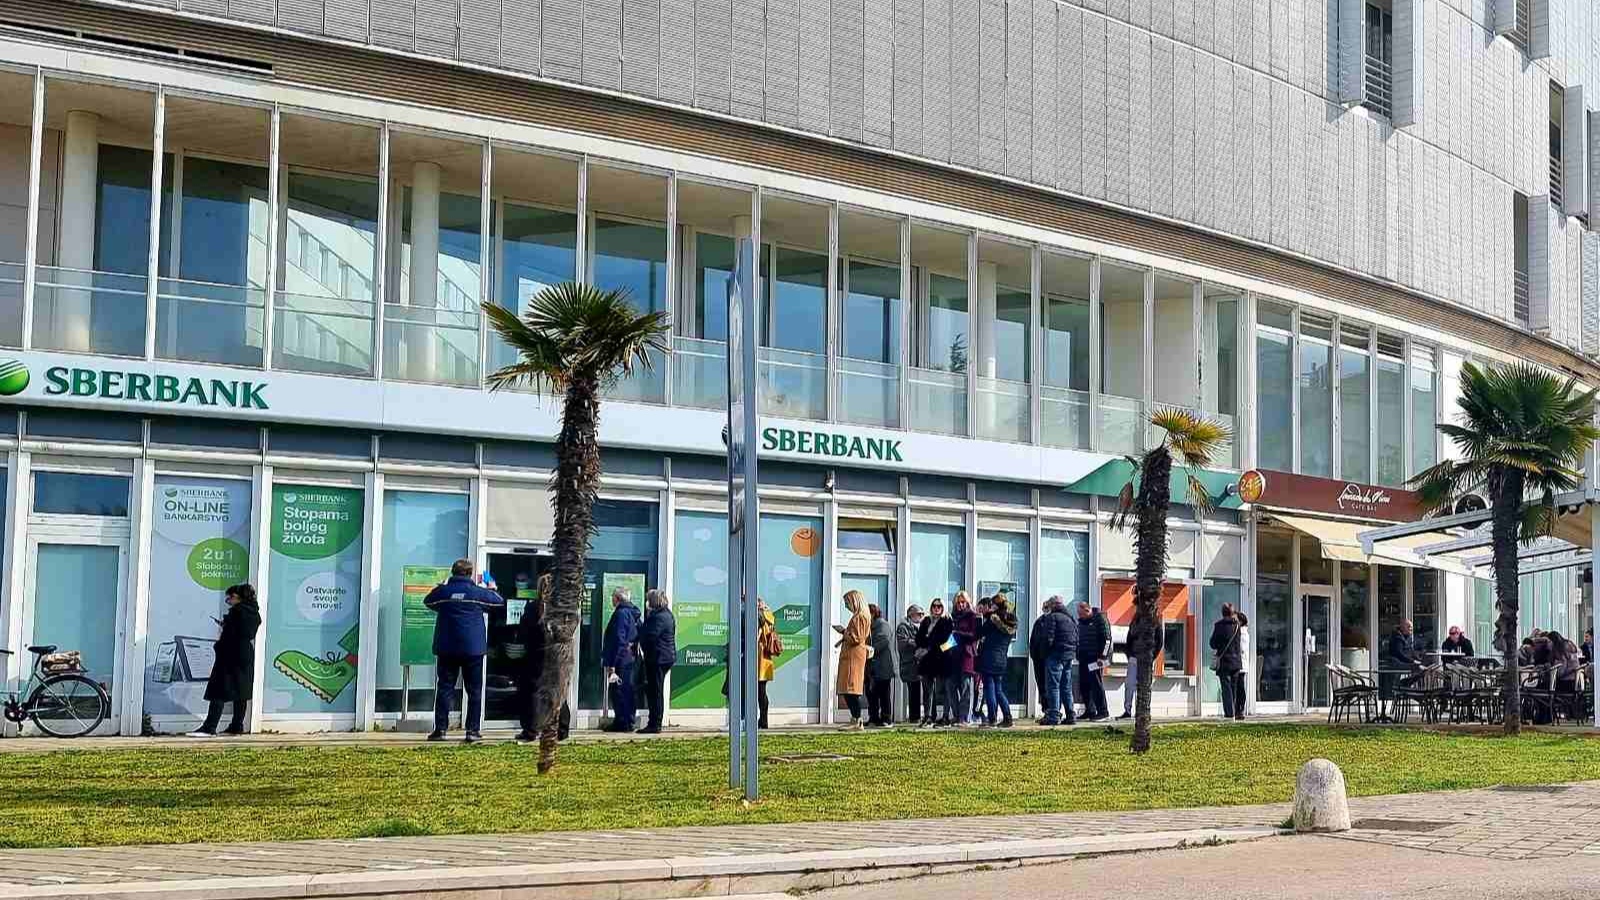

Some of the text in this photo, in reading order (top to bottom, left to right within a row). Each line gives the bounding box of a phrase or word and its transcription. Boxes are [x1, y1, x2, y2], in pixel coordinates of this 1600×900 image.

[45, 366, 269, 410] SBERBANK
[763, 428, 903, 462] SBERBANK
[164, 500, 231, 514] ON-LINE
[284, 506, 349, 521] Stopama
[164, 512, 230, 522] BANKARSTVO
[283, 519, 327, 535] boljeg
[282, 532, 326, 545] života
[305, 586, 347, 596] Ostvarite
[313, 595, 339, 604] svoje
